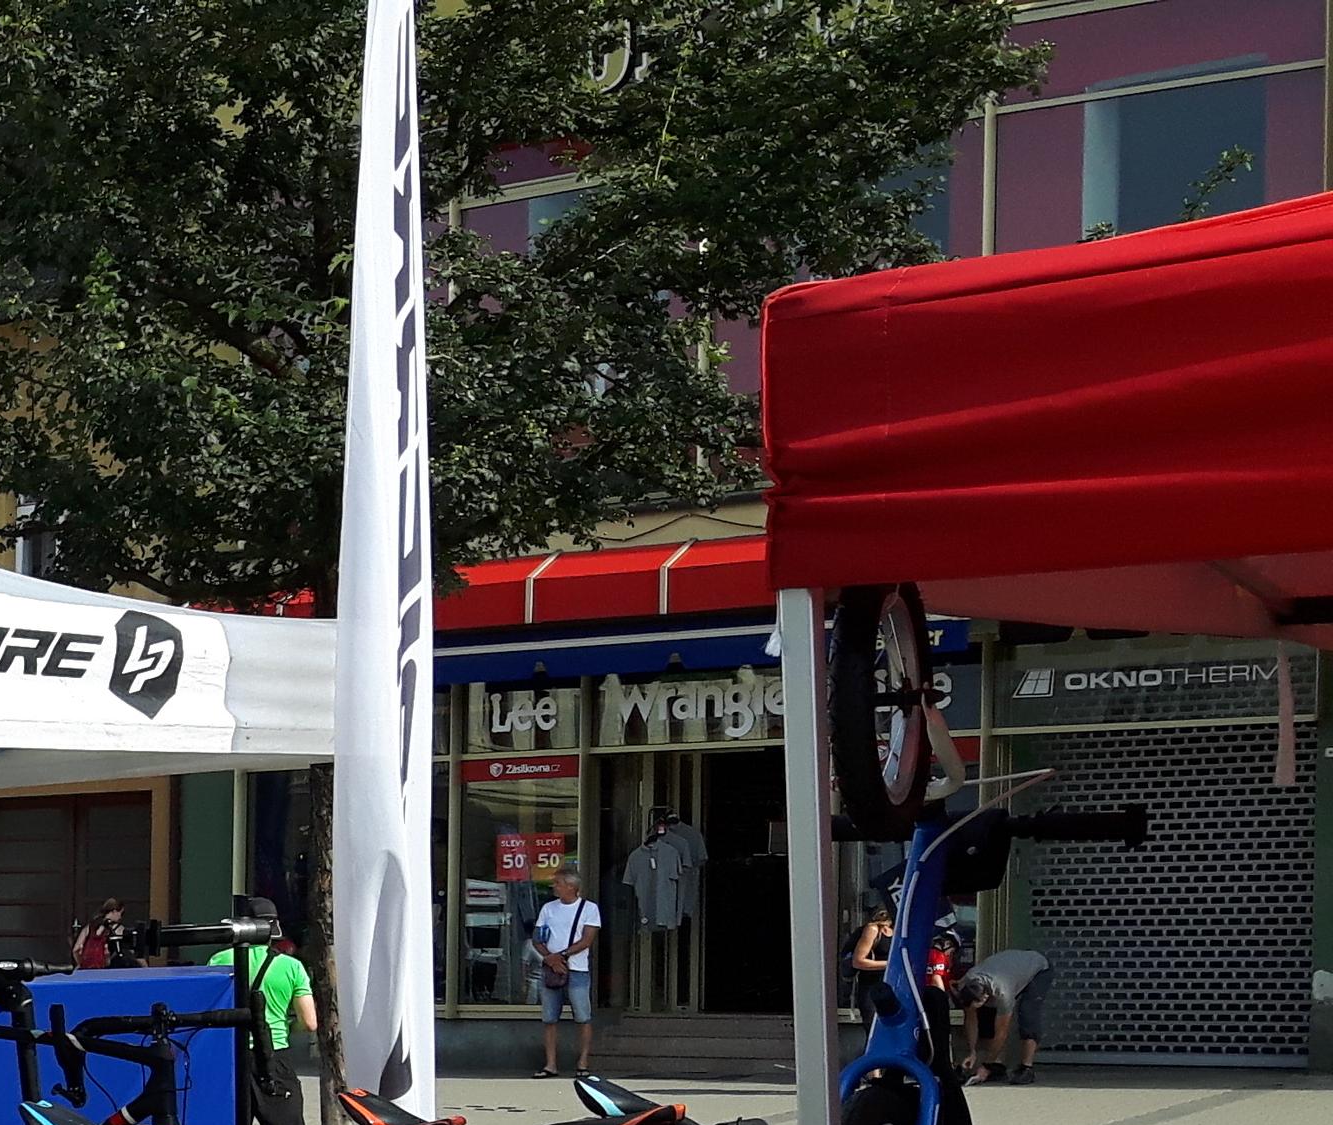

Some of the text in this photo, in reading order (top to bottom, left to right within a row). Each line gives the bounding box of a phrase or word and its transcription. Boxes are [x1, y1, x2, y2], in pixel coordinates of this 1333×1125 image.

[1063, 663, 1280, 691] OKNOTHERM
[490, 692, 559, 733] Lee
[599, 680, 784, 738] Wrangle
